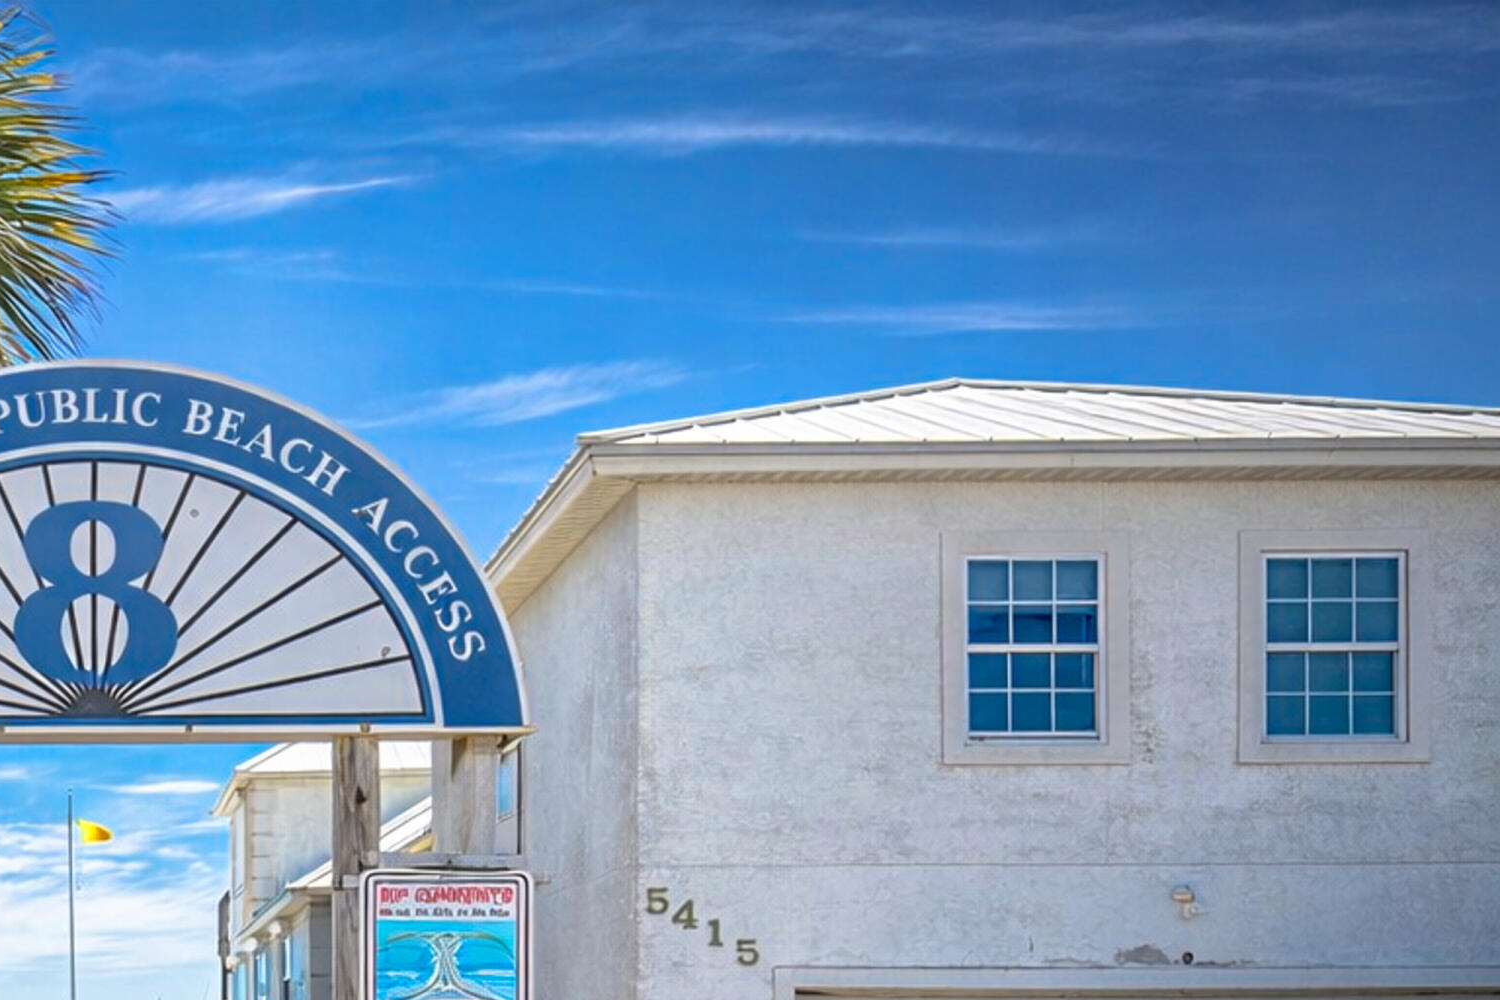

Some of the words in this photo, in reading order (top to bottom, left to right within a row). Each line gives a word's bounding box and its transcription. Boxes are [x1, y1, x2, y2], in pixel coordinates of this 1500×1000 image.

[13, 500, 177, 686] 8
[182, 399, 349, 497] BEACH
[352, 496, 486, 662] ACCESS
[646, 887, 759, 966] 5415
